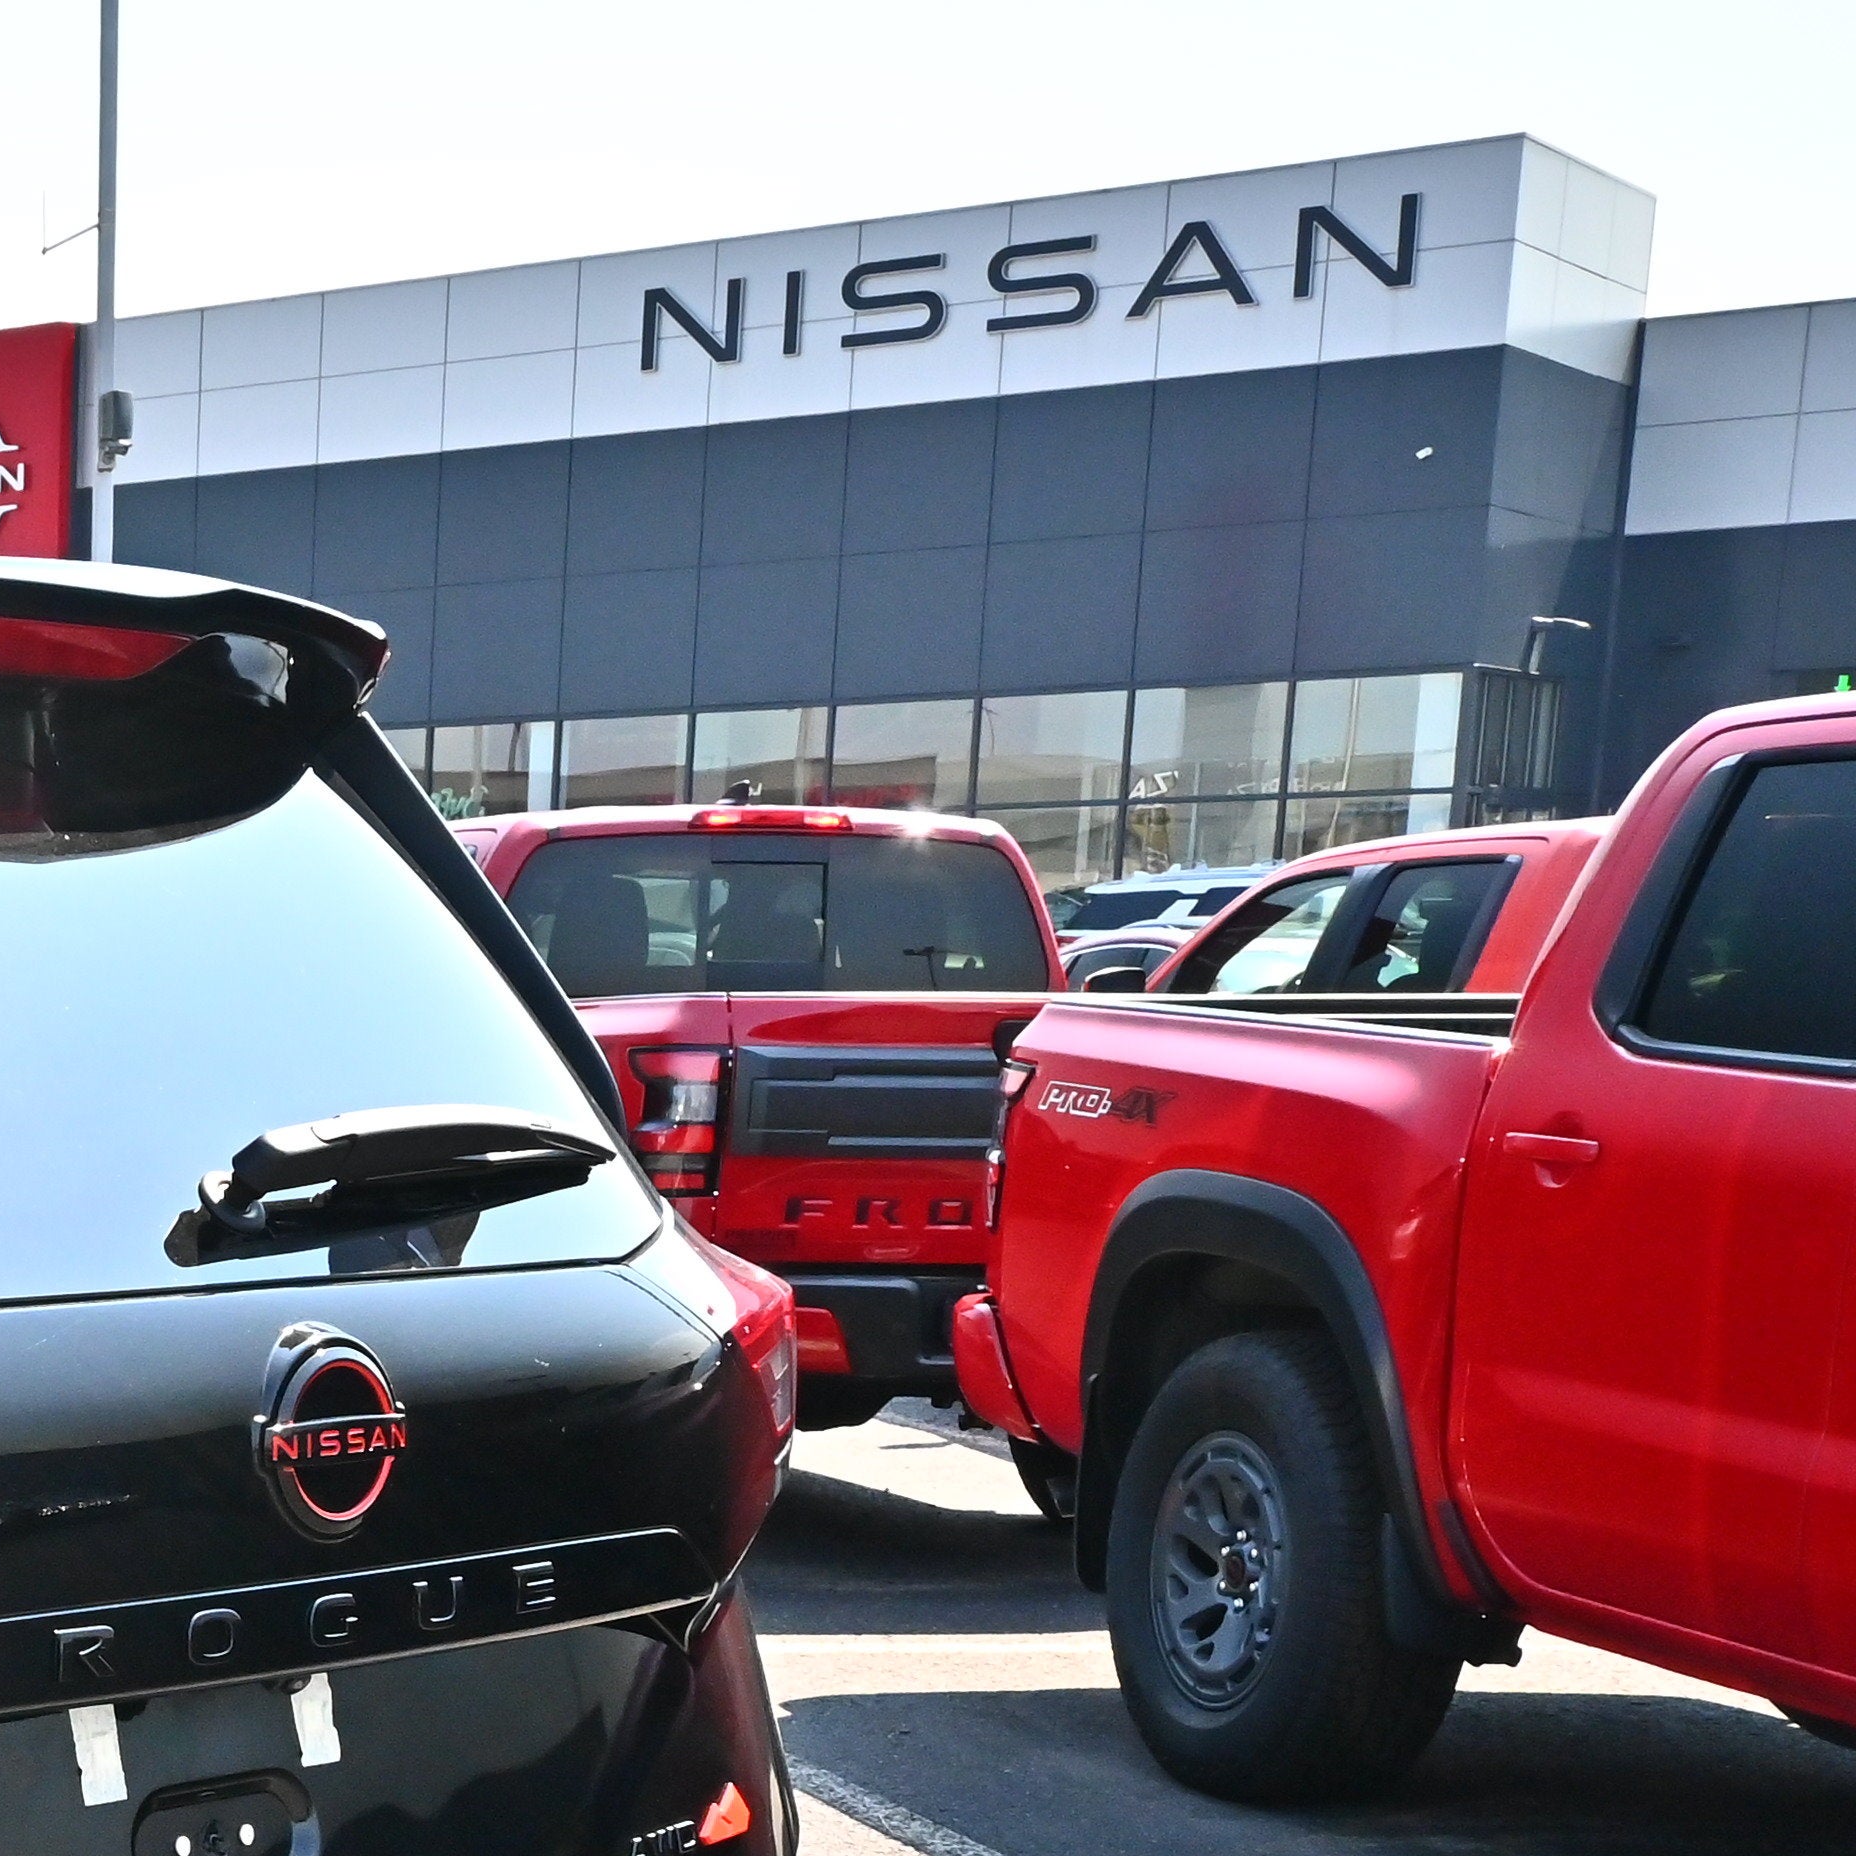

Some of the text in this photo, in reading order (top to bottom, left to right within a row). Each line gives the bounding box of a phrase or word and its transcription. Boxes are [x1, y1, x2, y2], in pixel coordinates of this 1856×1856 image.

[640, 191, 1424, 373] NISSAN
[271, 1422, 409, 1462] NISSAN
[53, 1560, 557, 1683] ROGUE
